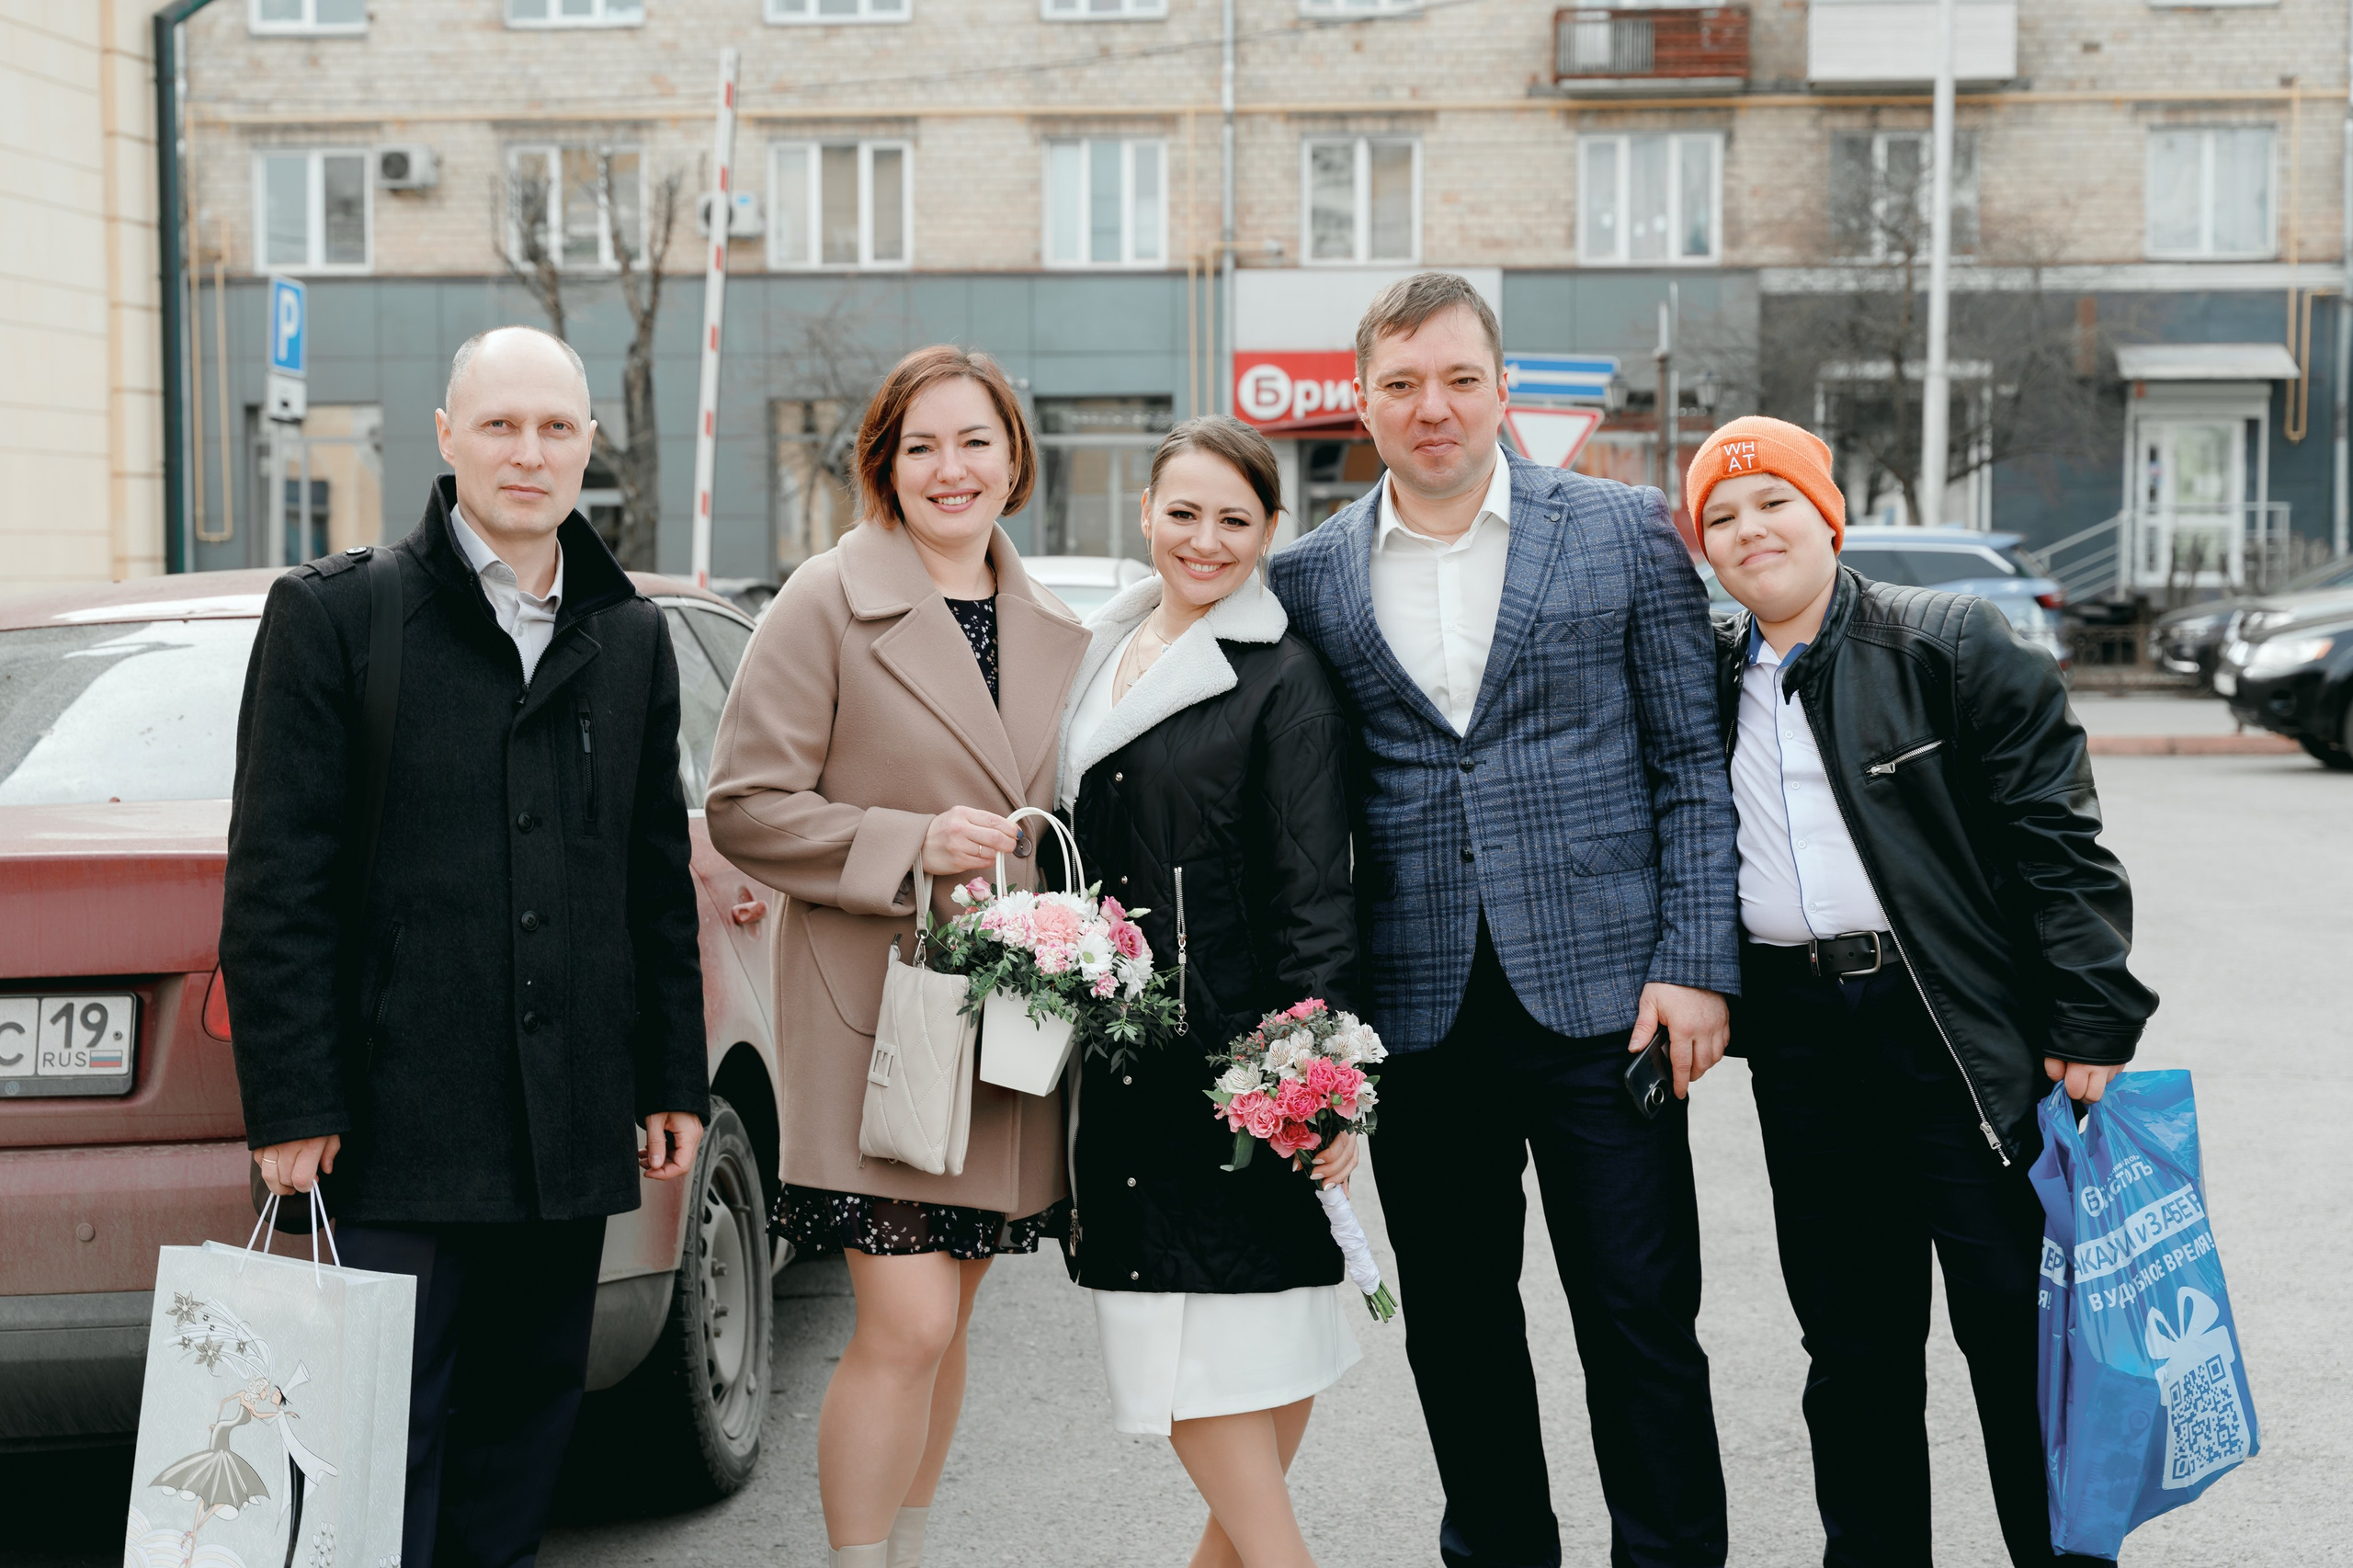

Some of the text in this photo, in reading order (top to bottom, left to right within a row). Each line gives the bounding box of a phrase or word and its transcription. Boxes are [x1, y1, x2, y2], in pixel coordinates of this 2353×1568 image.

[278, 288, 301, 361] P
[1237, 364, 1356, 421] Бри
[1723, 441, 1755, 456] WH
[1728, 453, 1756, 472] AT
[50, 1002, 108, 1049] 19
[42, 1051, 87, 1068] RUS
[2088, 1293, 2104, 1312] В
